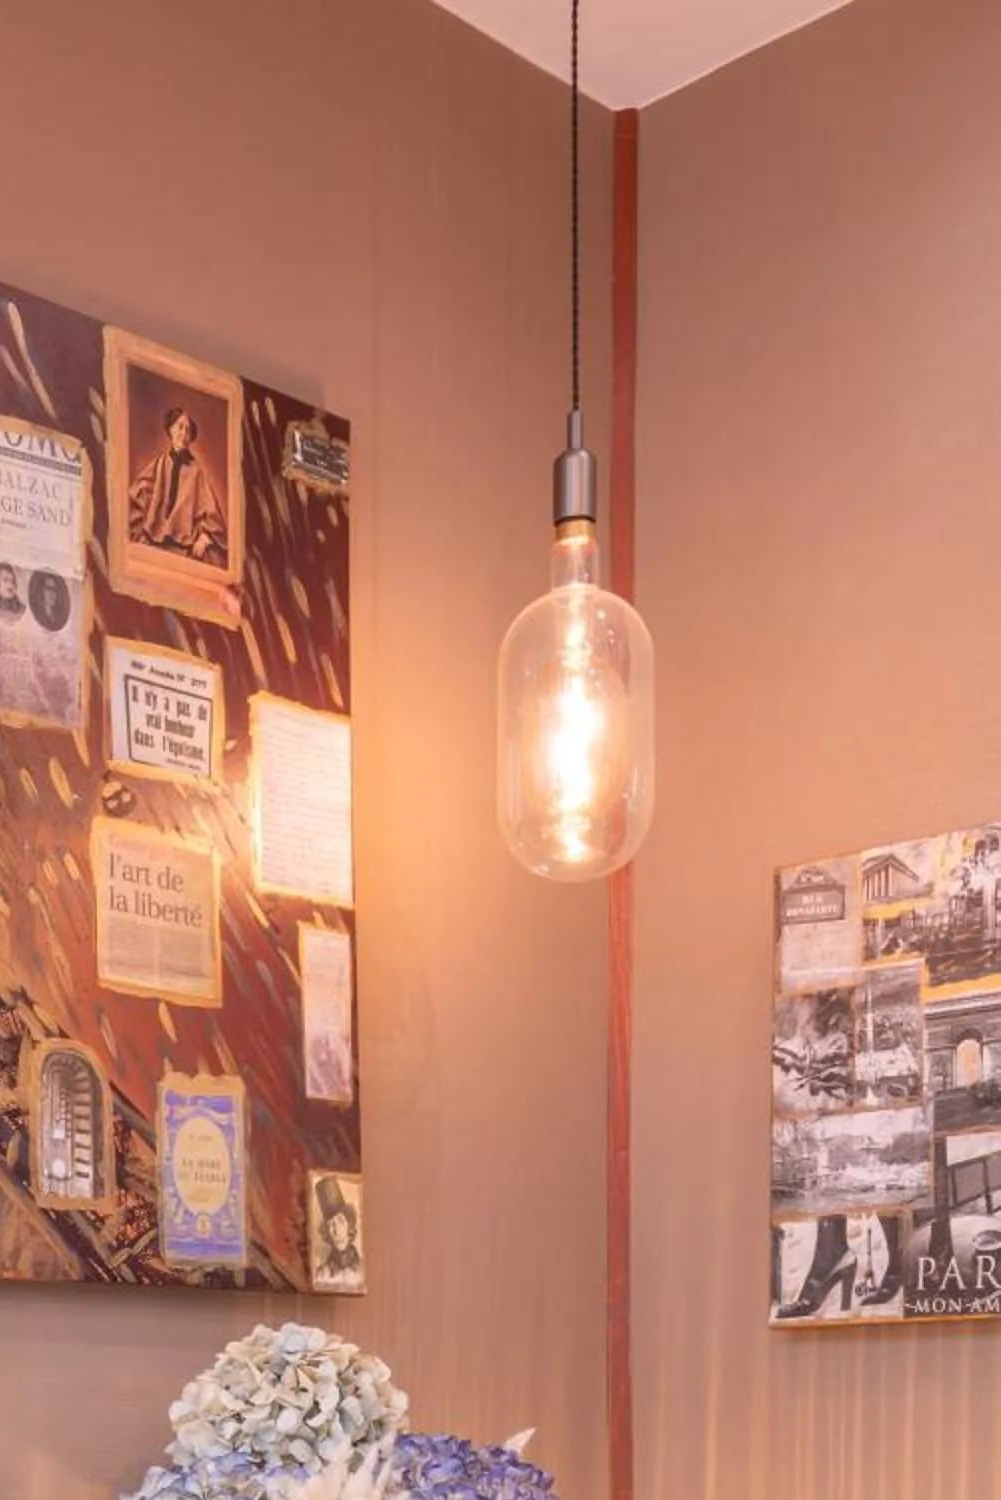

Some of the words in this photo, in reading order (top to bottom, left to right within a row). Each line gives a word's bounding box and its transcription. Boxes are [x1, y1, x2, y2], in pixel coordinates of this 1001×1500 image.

[27, 501, 72, 527] SAND
[109, 852, 151, 886] l'art
[156, 866, 184, 893] de
[109, 886, 128, 913] la
[134, 890, 203, 928] liberté
[915, 1255, 1001, 1291] PAR
[914, 1297, 963, 1313] MON
